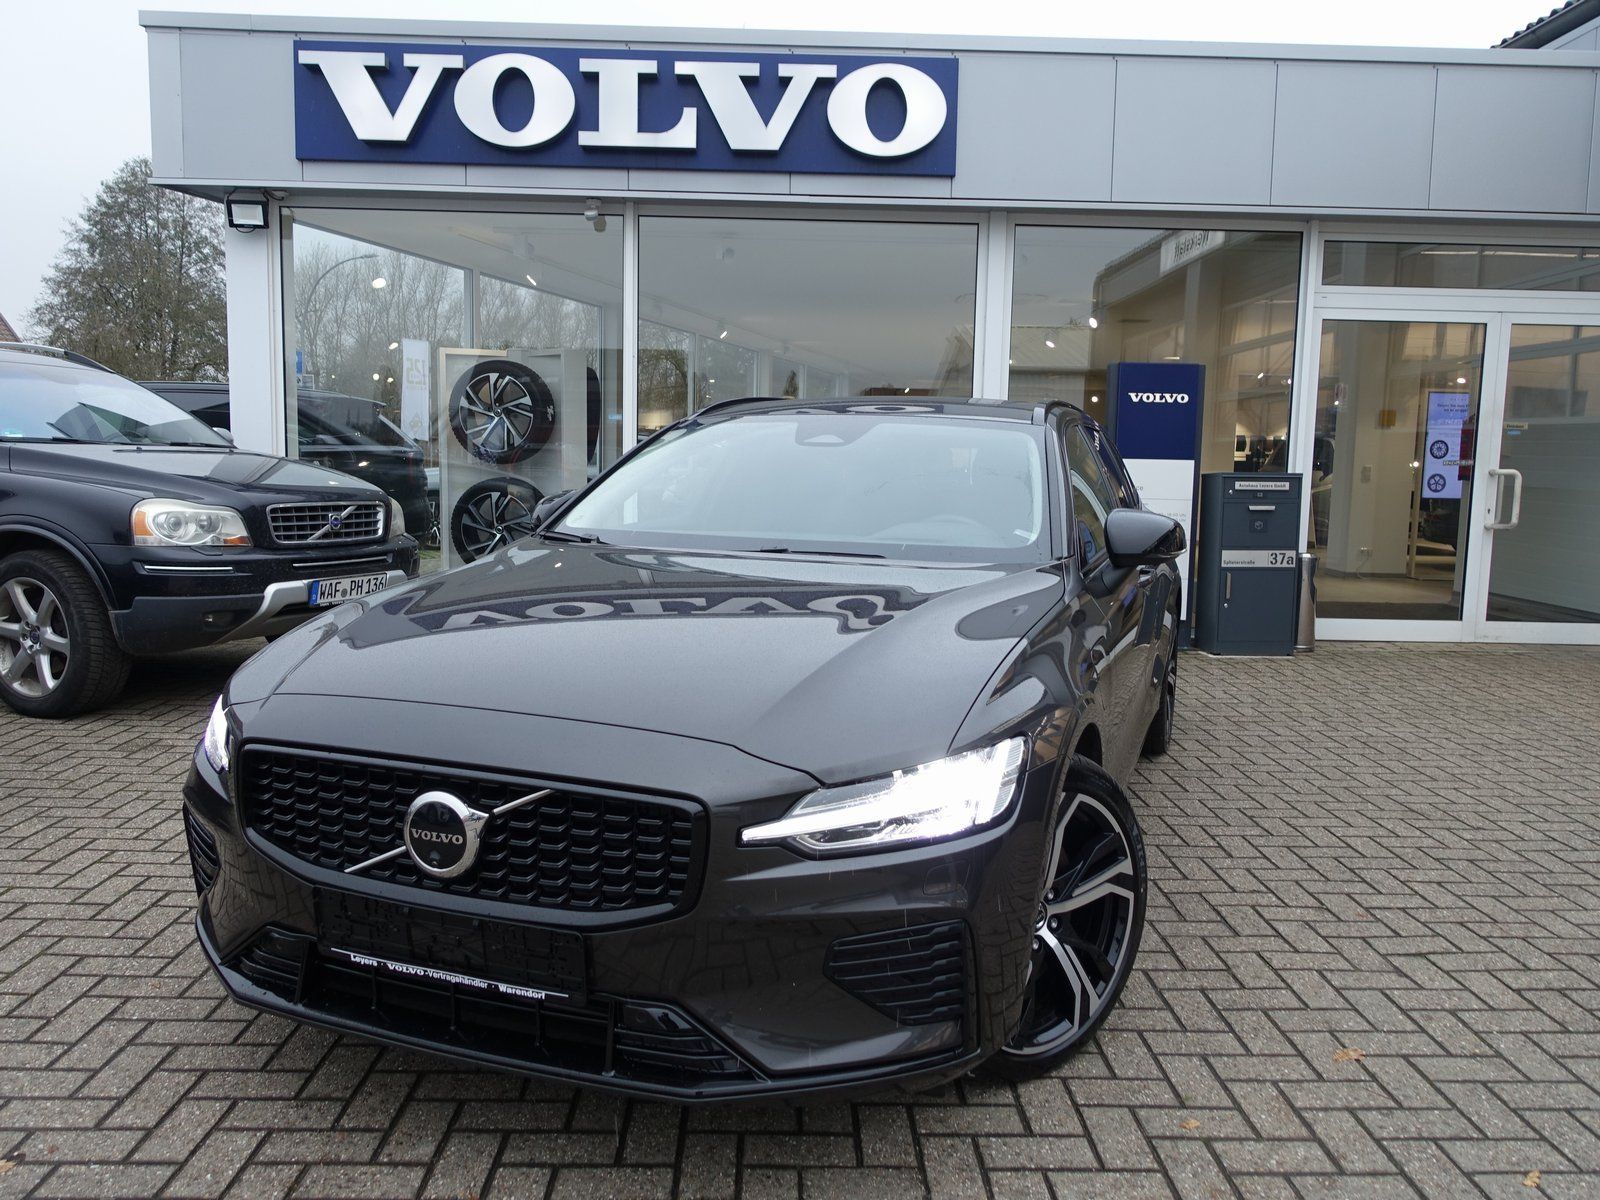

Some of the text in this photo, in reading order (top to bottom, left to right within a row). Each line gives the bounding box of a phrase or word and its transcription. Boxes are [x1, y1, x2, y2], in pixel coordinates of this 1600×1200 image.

[298, 50, 948, 158] VOLVO
[1128, 392, 1190, 404] VOLVO
[1270, 552, 1294, 566] 37a
[320, 576, 384, 600] WAF PH 136
[410, 827, 464, 845] VOLVO
[350, 953, 378, 967] Leyers
[498, 984, 546, 1000] Warendorf
